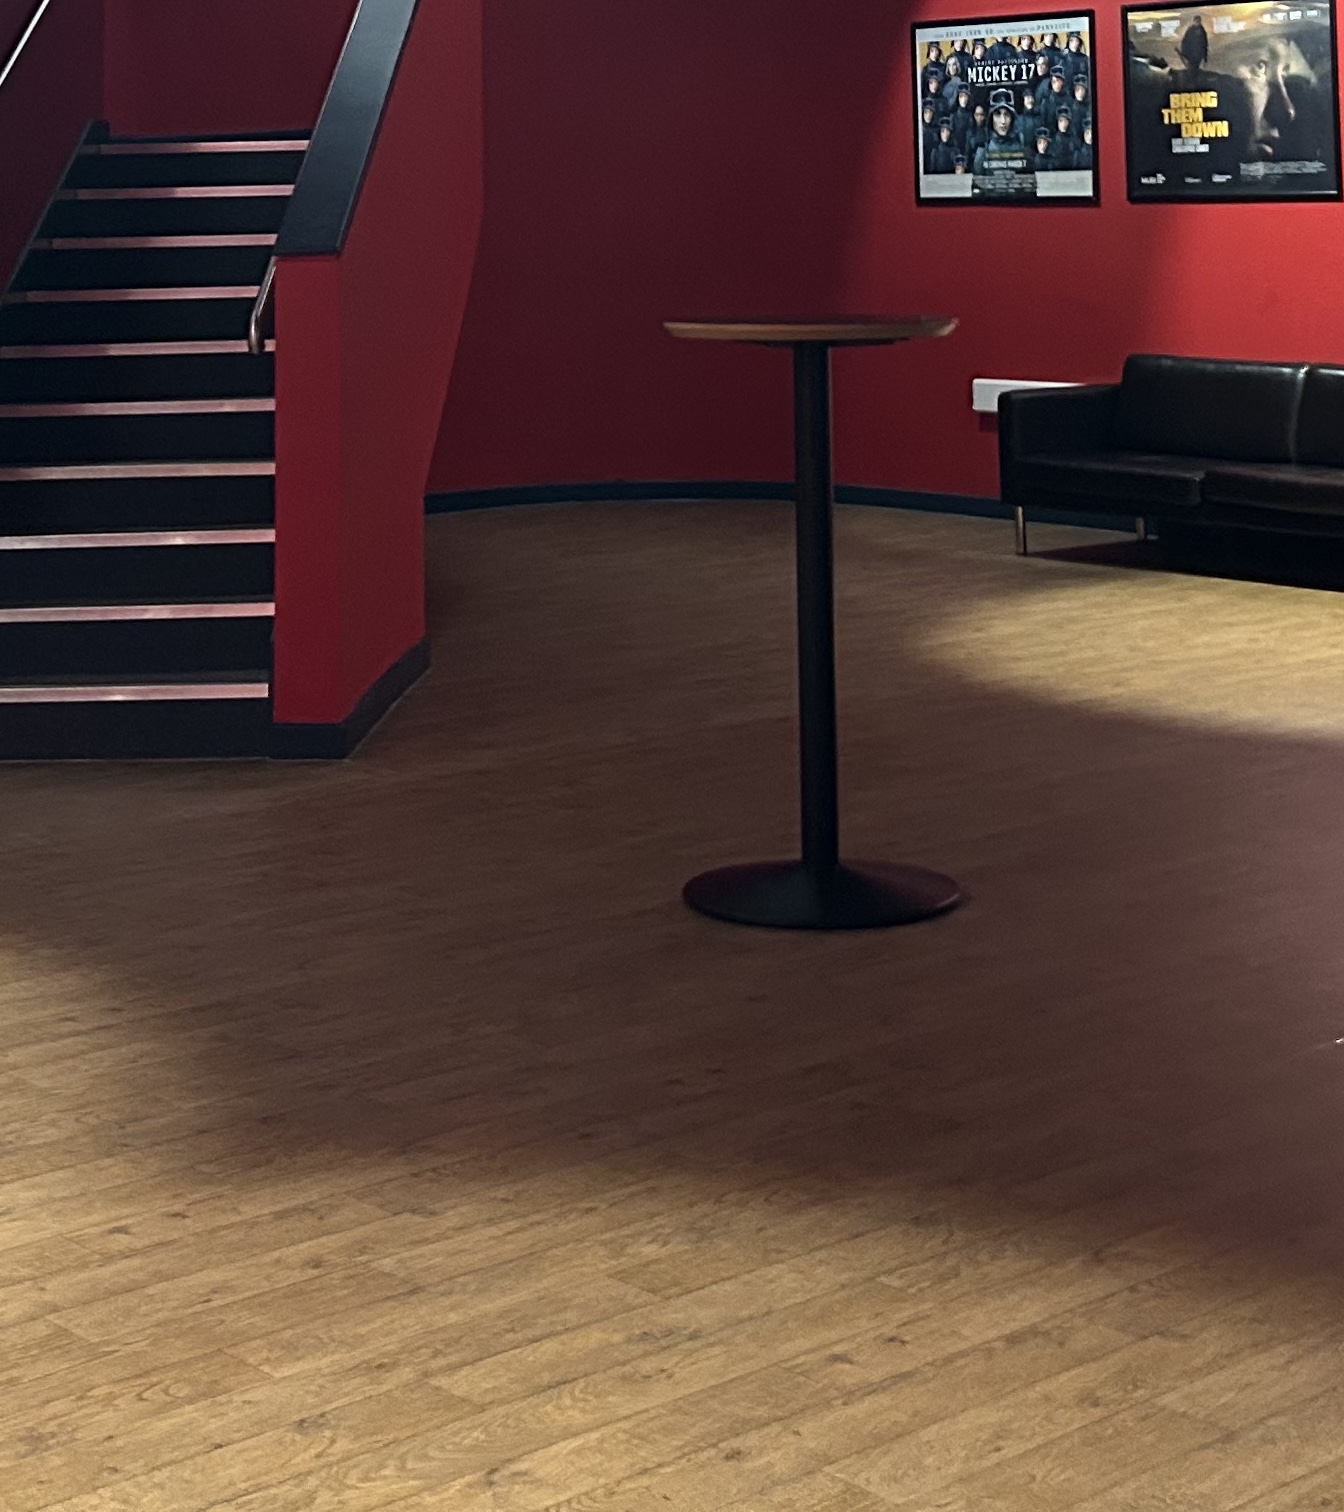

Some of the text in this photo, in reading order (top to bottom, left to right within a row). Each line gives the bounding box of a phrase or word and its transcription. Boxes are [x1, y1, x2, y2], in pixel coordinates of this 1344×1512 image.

[967, 63, 1036, 84] MICKEY 17
[1169, 91, 1218, 109] BRING
[1161, 108, 1204, 125] THEM
[1181, 120, 1229, 138] DOWN
